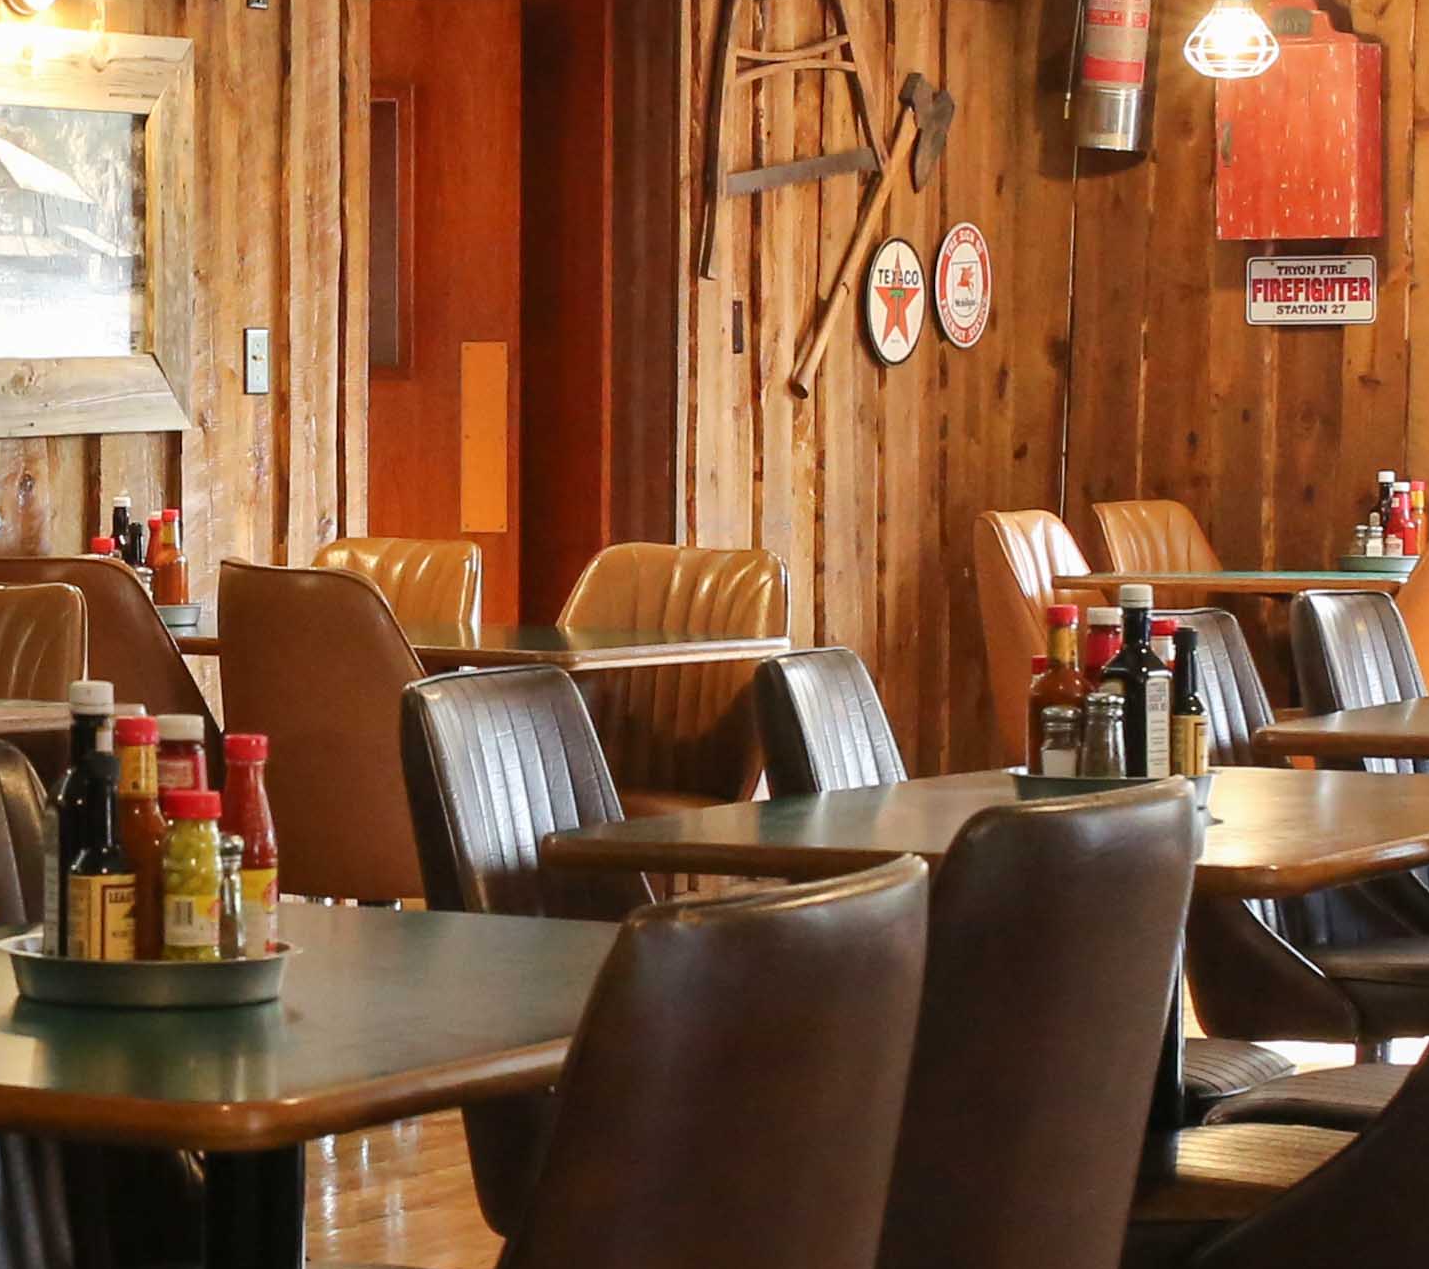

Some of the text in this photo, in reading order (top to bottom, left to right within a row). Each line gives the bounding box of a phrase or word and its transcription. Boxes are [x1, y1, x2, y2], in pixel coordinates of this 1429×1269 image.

[878, 268, 920, 286] TEXACO
[1277, 264, 1347, 276] TRYON FIRE
[1252, 276, 1372, 303] FIREFIGHTER
[1276, 304, 1347, 315] STATION 27
